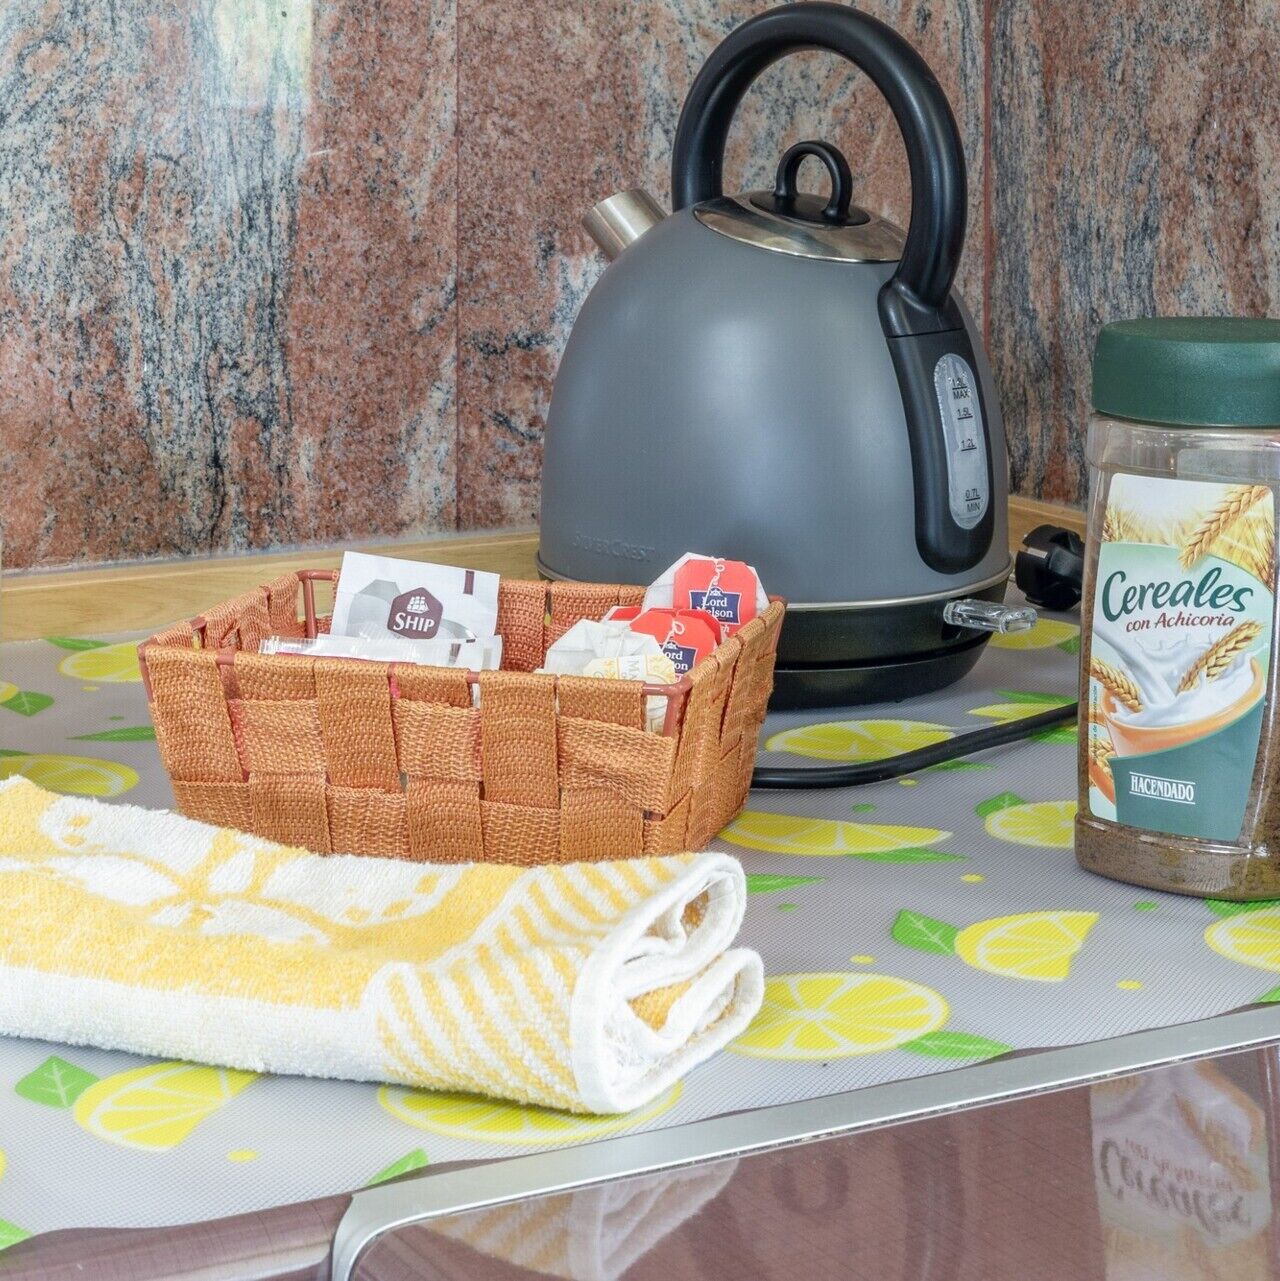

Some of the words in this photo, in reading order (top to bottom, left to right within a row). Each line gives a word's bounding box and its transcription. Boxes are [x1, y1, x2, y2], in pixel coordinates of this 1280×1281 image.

[953, 390, 969, 400] MAX
[957, 407, 972, 417] 1.5L
[961, 438, 976, 449] 1.2L
[965, 488, 980, 498] 0.7L
[967, 501, 981, 513] MIN
[1102, 567, 1254, 622] Cereales
[701, 596, 728, 608] Lord
[393, 612, 435, 633] SHIP
[1126, 619, 1151, 633] con
[1155, 611, 1235, 629] Achicoria
[664, 651, 683, 661] ord
[1131, 775, 1194, 801] HACENDADO
